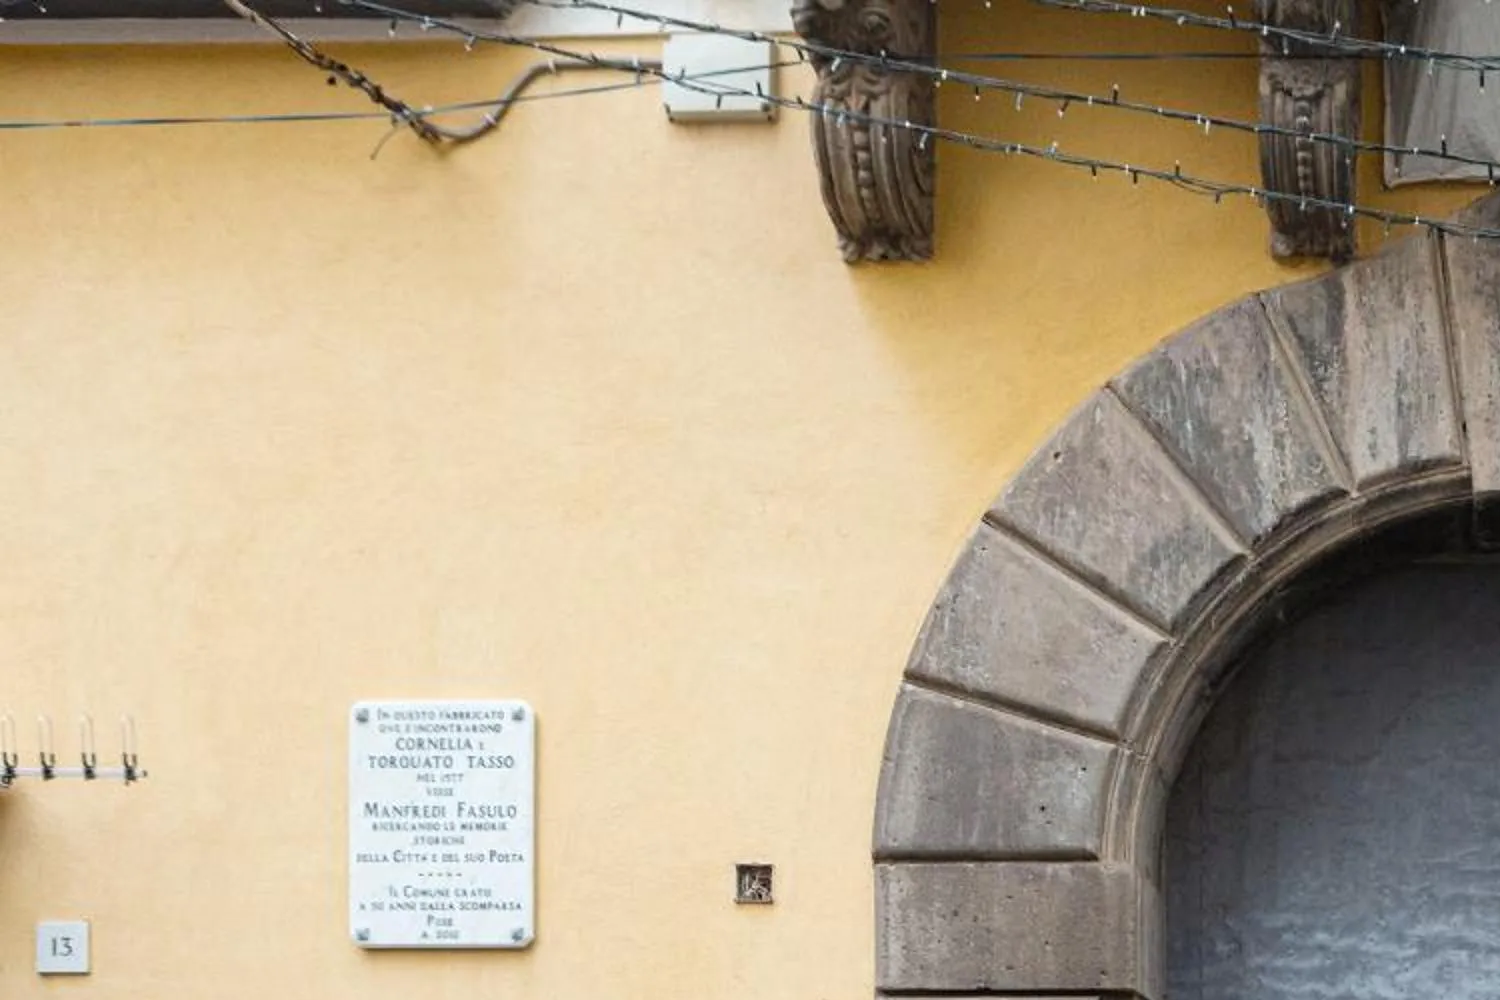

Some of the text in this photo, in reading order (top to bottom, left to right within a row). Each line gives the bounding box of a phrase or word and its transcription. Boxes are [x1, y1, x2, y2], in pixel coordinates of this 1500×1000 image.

[395, 737, 473, 751] CORNELIA
[368, 756, 515, 769] TORQUATO TASSO
[364, 801, 517, 818] MANFREDI FASULO
[489, 850, 524, 863] POETA
[459, 902, 521, 911] SCOMPARSA
[51, 936, 74, 957] 13
